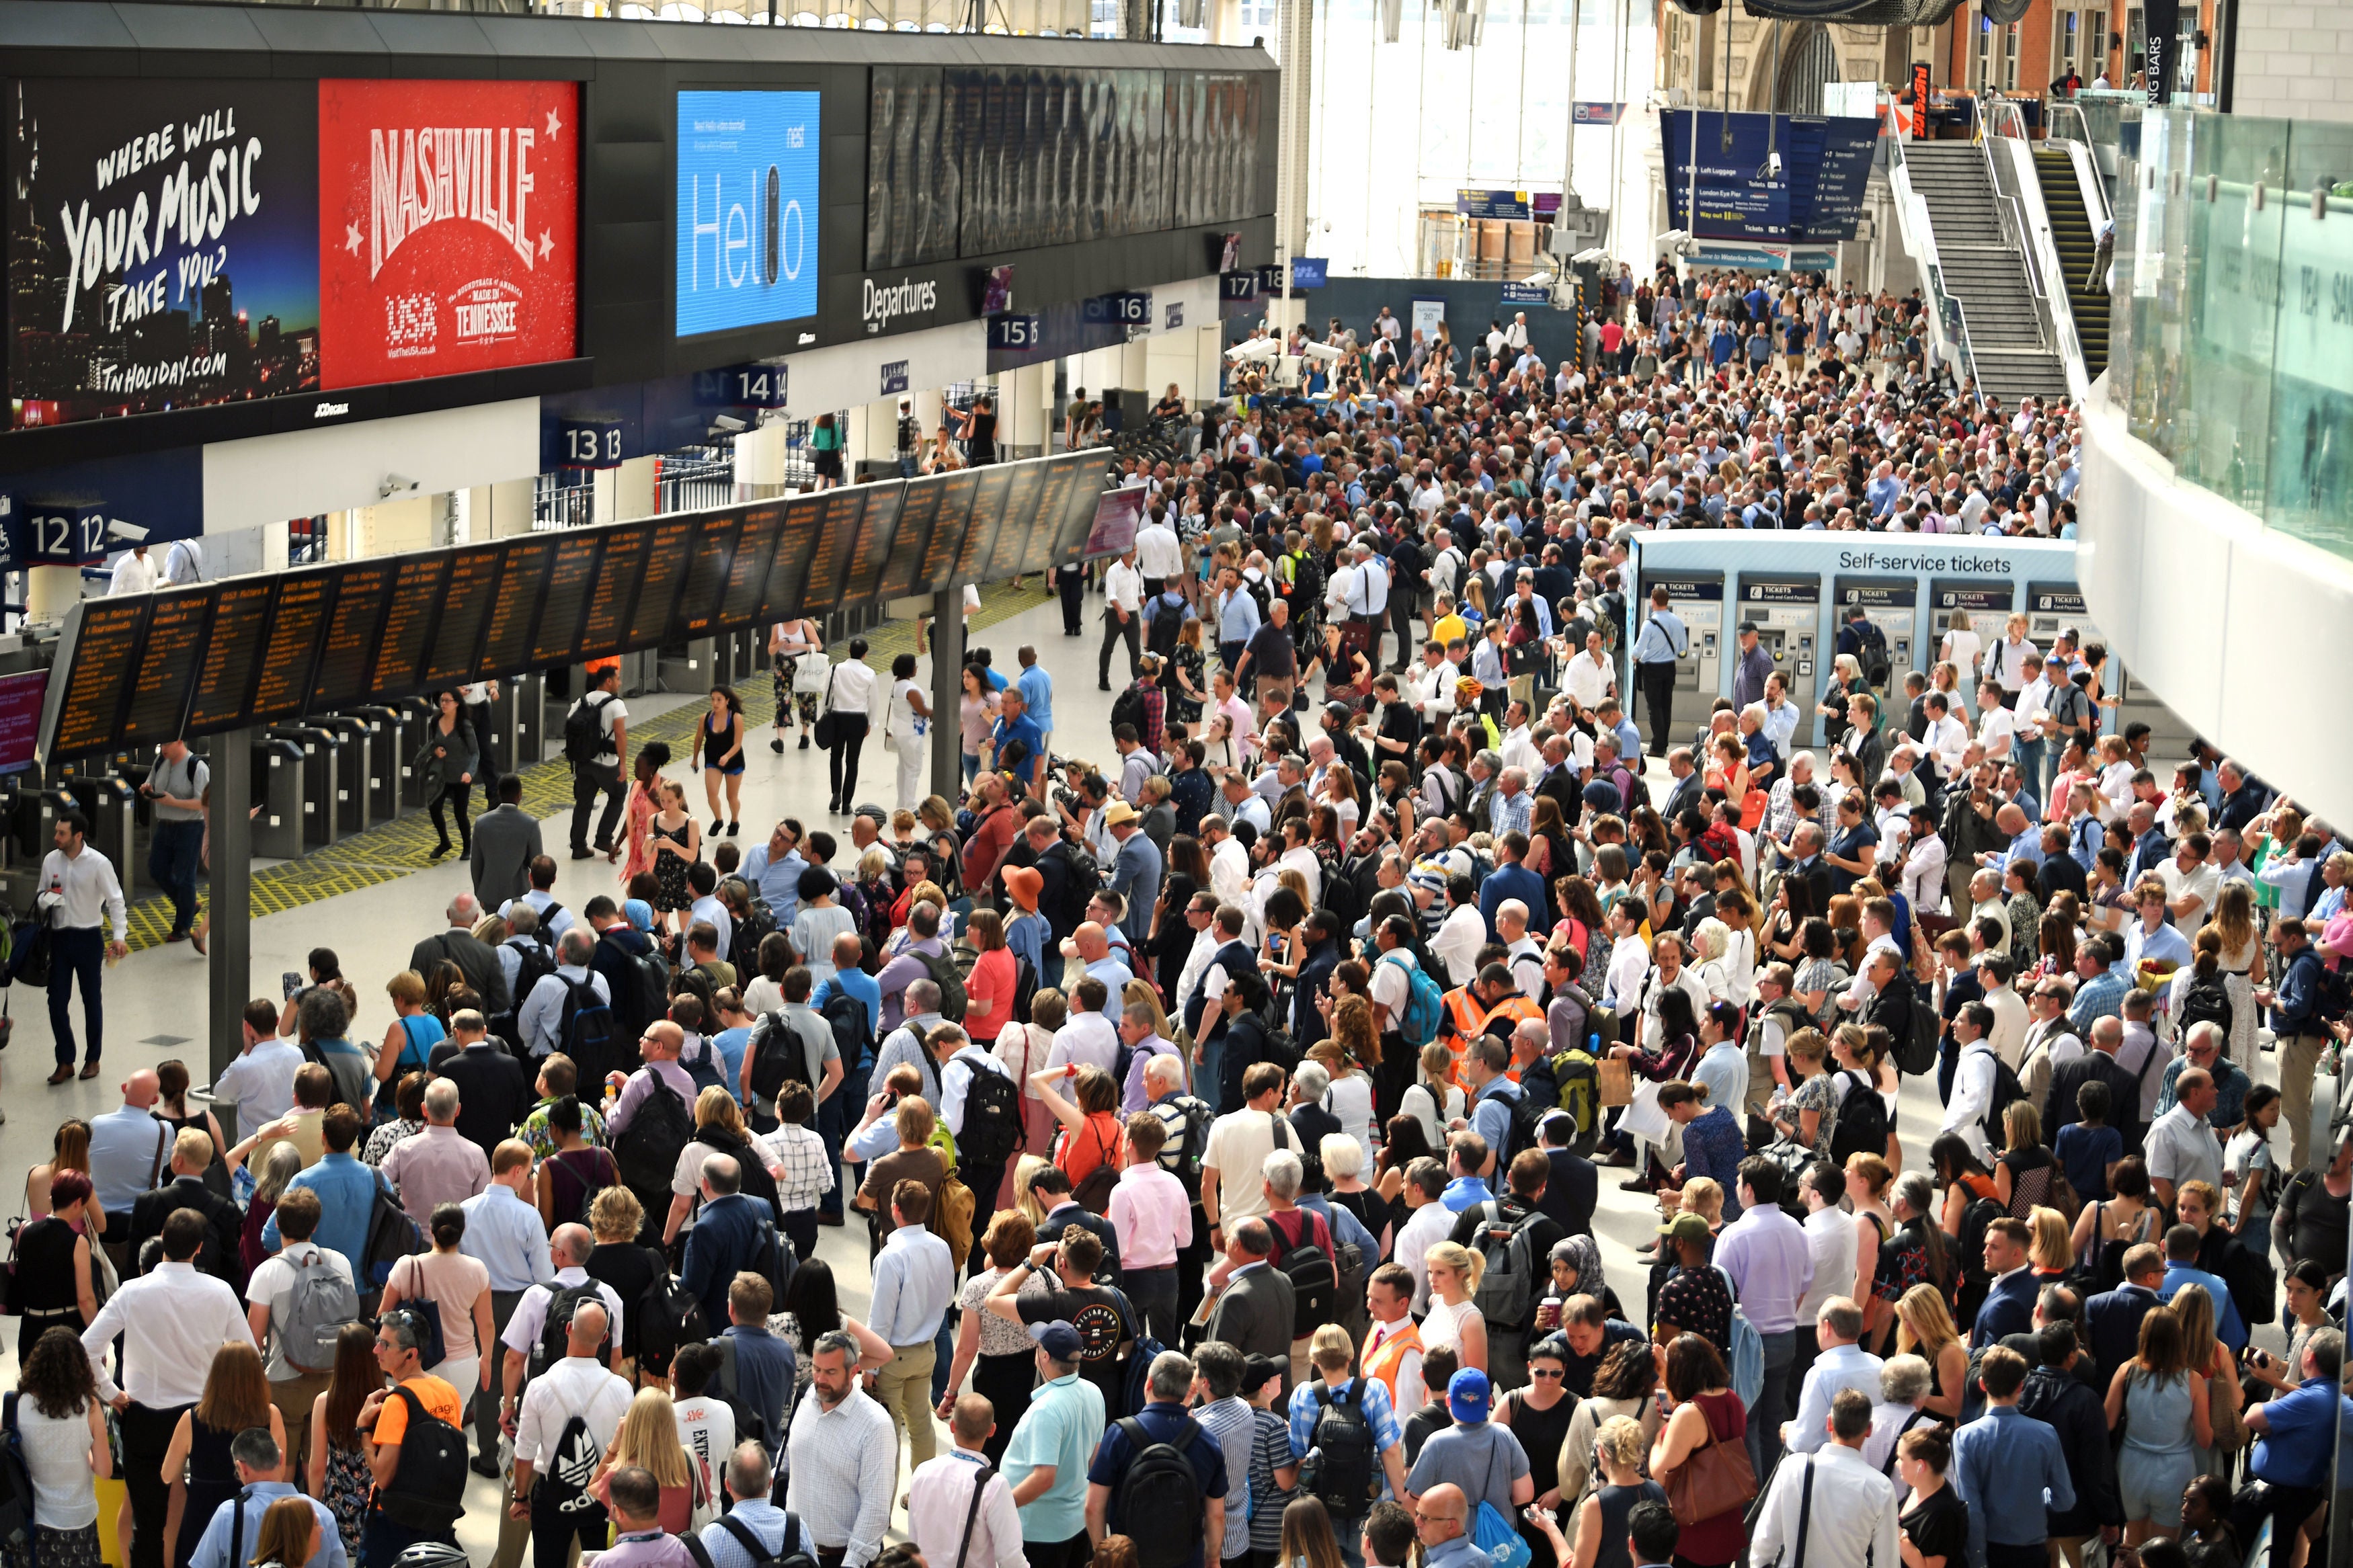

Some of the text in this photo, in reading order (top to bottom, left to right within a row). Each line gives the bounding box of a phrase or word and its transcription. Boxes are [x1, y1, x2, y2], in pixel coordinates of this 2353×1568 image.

[2149, 36, 2161, 75] BARS
[787, 124, 805, 149] nest
[96, 107, 236, 191] WHERE WILL
[1712, 167, 1737, 175] Luggage
[370, 127, 534, 282] NASHVILLE
[1699, 200, 1733, 209] Underground
[1720, 190, 1730, 198] Eye
[61, 136, 262, 333] YOUR MUSIC
[1721, 254, 1747, 262] Waterloo
[1748, 255, 1768, 263] Station
[108, 245, 227, 333] TAKE YOU?
[457, 278, 493, 296] SOUNDTRACK
[500, 280, 523, 298] AMERICA
[1229, 277, 1249, 296] 17
[1253, 276, 1259, 294] 17
[1265, 270, 1283, 288] 18
[472, 288, 500, 302] MADE IN
[863, 277, 936, 327] Departures
[386, 292, 437, 345] USA
[456, 300, 517, 337] TENNESSEE
[1118, 298, 1142, 319] 16
[1146, 298, 1152, 319] 16
[1001, 321, 1026, 343] 15
[1031, 321, 1038, 343] 15
[387, 345, 436, 359] VisitTheUSA.co.uk
[739, 372, 770, 400] 14
[775, 372, 786, 400] 14
[314, 403, 349, 418] JCDecaux
[567, 429, 598, 460] 13
[606, 429, 621, 460] 13
[32, 515, 70, 554] 12
[81, 514, 104, 553] 12
[1839, 552, 2011, 573] Self-service tickets
[1076, 1309, 1116, 1328] BILLABONG
[1082, 1339, 1113, 1356] STRALIA
